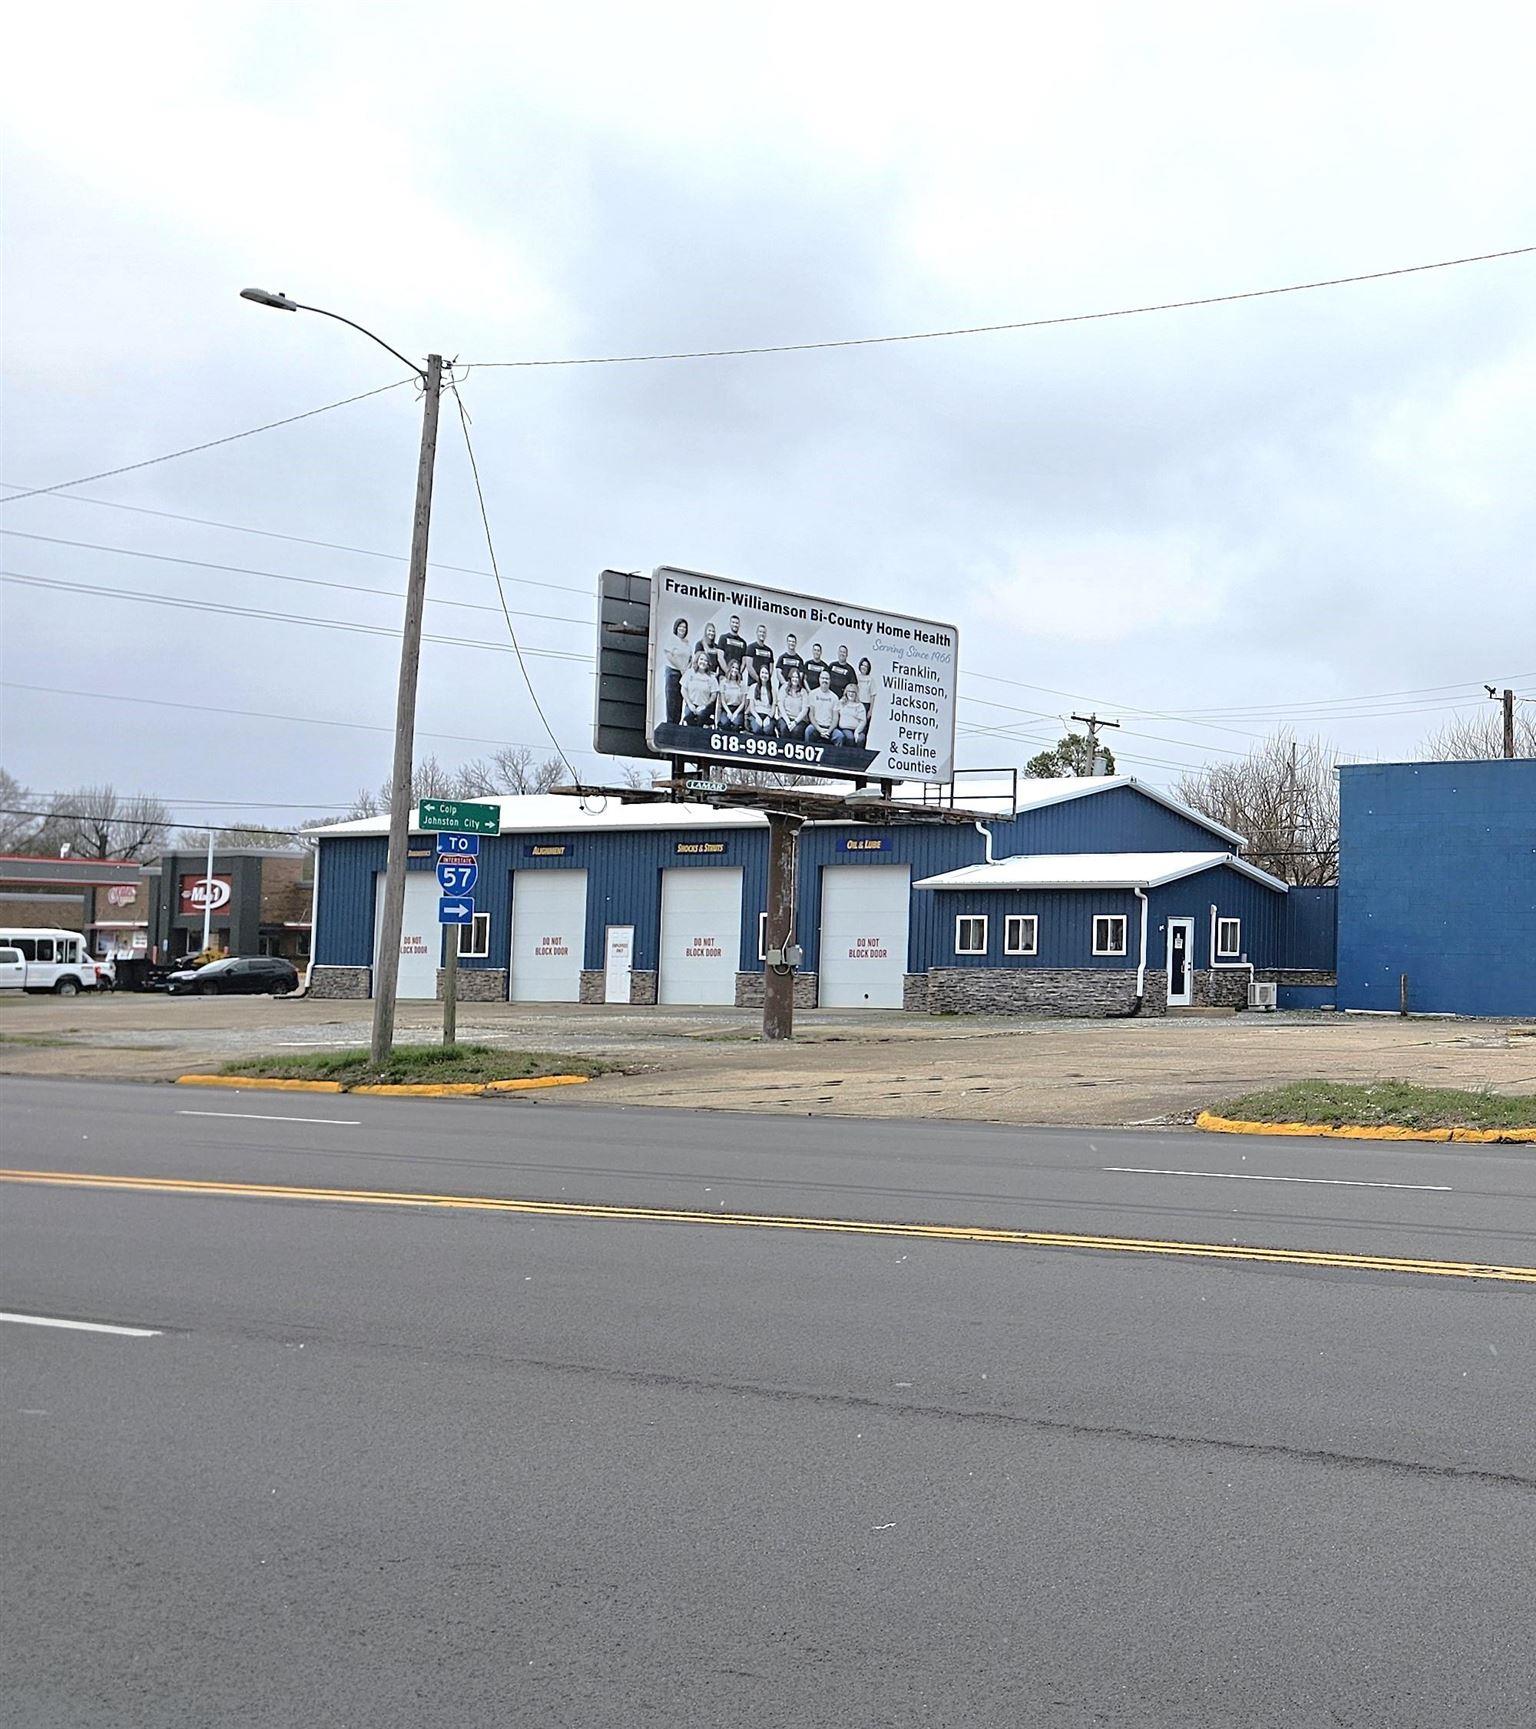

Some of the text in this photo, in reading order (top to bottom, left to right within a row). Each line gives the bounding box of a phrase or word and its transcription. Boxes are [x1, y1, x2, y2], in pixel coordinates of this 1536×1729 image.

[665, 579, 951, 647] Franklin-Williamson Bi-County Home Health
[873, 639, 904, 659] Serving
[906, 645, 929, 660] Since
[892, 661, 940, 682] Franklin,
[883, 675, 948, 699] Williamson,
[891, 693, 939, 714] Jackson,
[889, 709, 939, 729] Johnson,
[899, 727, 929, 744] Perry
[710, 734, 824, 762] 618-998-0507
[889, 741, 937, 758] & Saline
[888, 757, 938, 774] Counties
[690, 781, 723, 791] LAMAR
[440, 804, 457, 816] Colp
[423, 816, 480, 829] Johnston City
[449, 837, 468, 850] TO
[443, 867, 471, 887] 57
[694, 938, 715, 946] DO NOT
[857, 938, 879, 947] DO NOT
[686, 948, 721, 957] BLOCK DOOR
[849, 949, 887, 958] BLOCK DOOR
